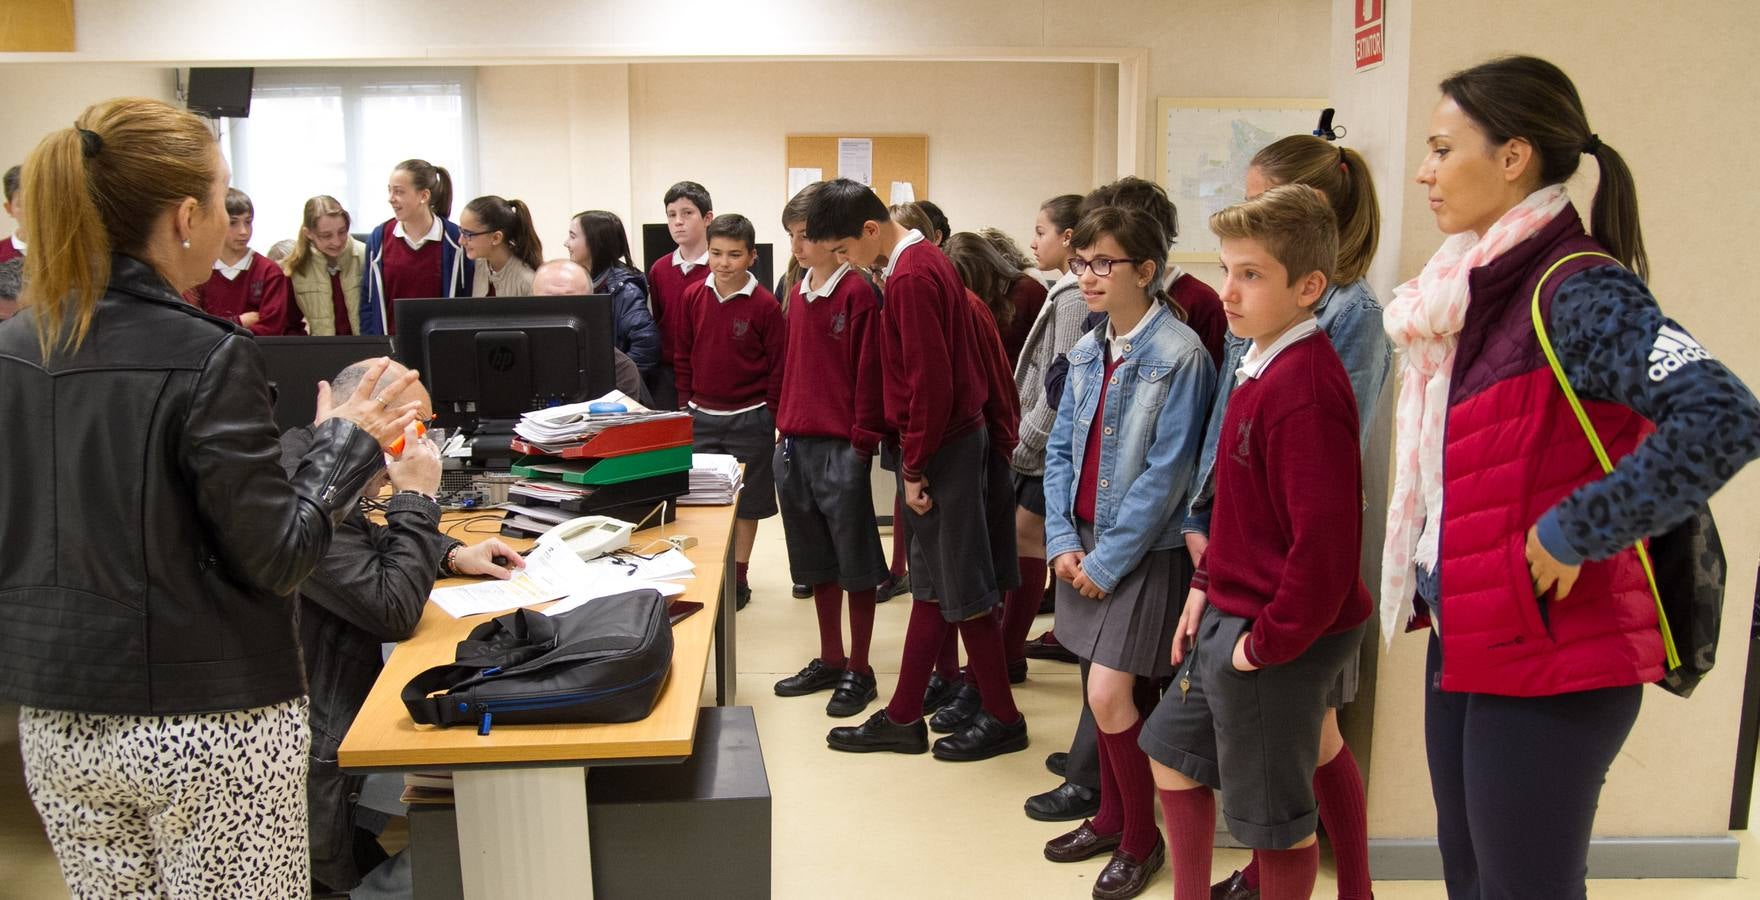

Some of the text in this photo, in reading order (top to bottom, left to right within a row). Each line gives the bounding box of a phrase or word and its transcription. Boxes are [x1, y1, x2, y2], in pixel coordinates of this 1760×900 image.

[1357, 32, 1381, 60] EXTINTOR
[491, 346, 512, 371] hp
[1648, 348, 1712, 382] adida
